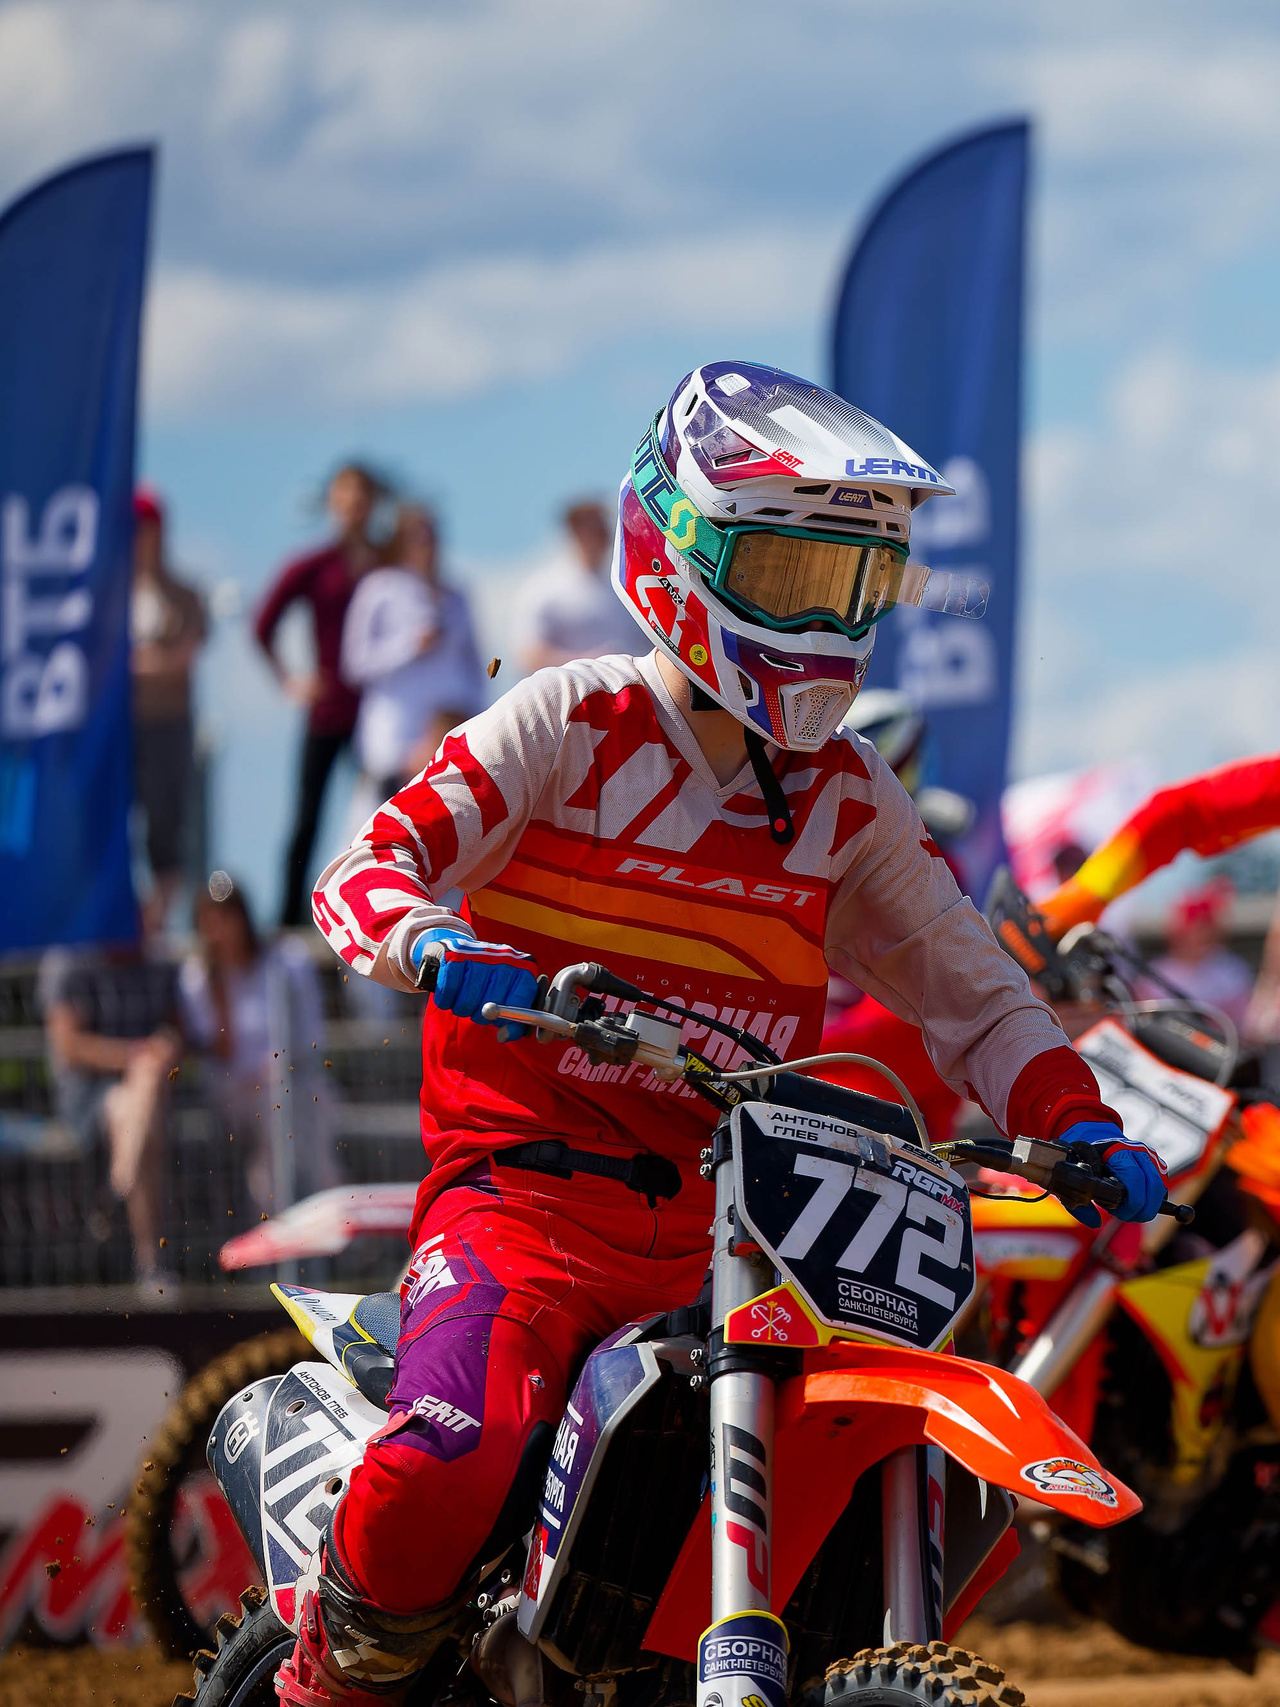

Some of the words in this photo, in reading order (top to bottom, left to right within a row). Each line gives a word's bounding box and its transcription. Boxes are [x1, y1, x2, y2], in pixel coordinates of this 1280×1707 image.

[772, 448, 804, 468] LEATT
[845, 458, 938, 483] LEATT
[838, 491, 867, 503] LEATT
[615, 858, 816, 907] PLAST
[636, 974, 777, 1006] HORIZON
[771, 1112, 858, 1138] АНТОНОВ
[773, 1126, 819, 1141] ГЛЕБ
[776, 1153, 964, 1312] 772
[838, 1283, 918, 1319] СБОРНАЯ
[838, 1297, 919, 1331] САНКТ-ПЕТЕРБУРГА
[298, 1371, 331, 1403] АНТОНОВ
[327, 1400, 349, 1420] ГЛЕБ
[407, 1394, 482, 1433] LEATT
